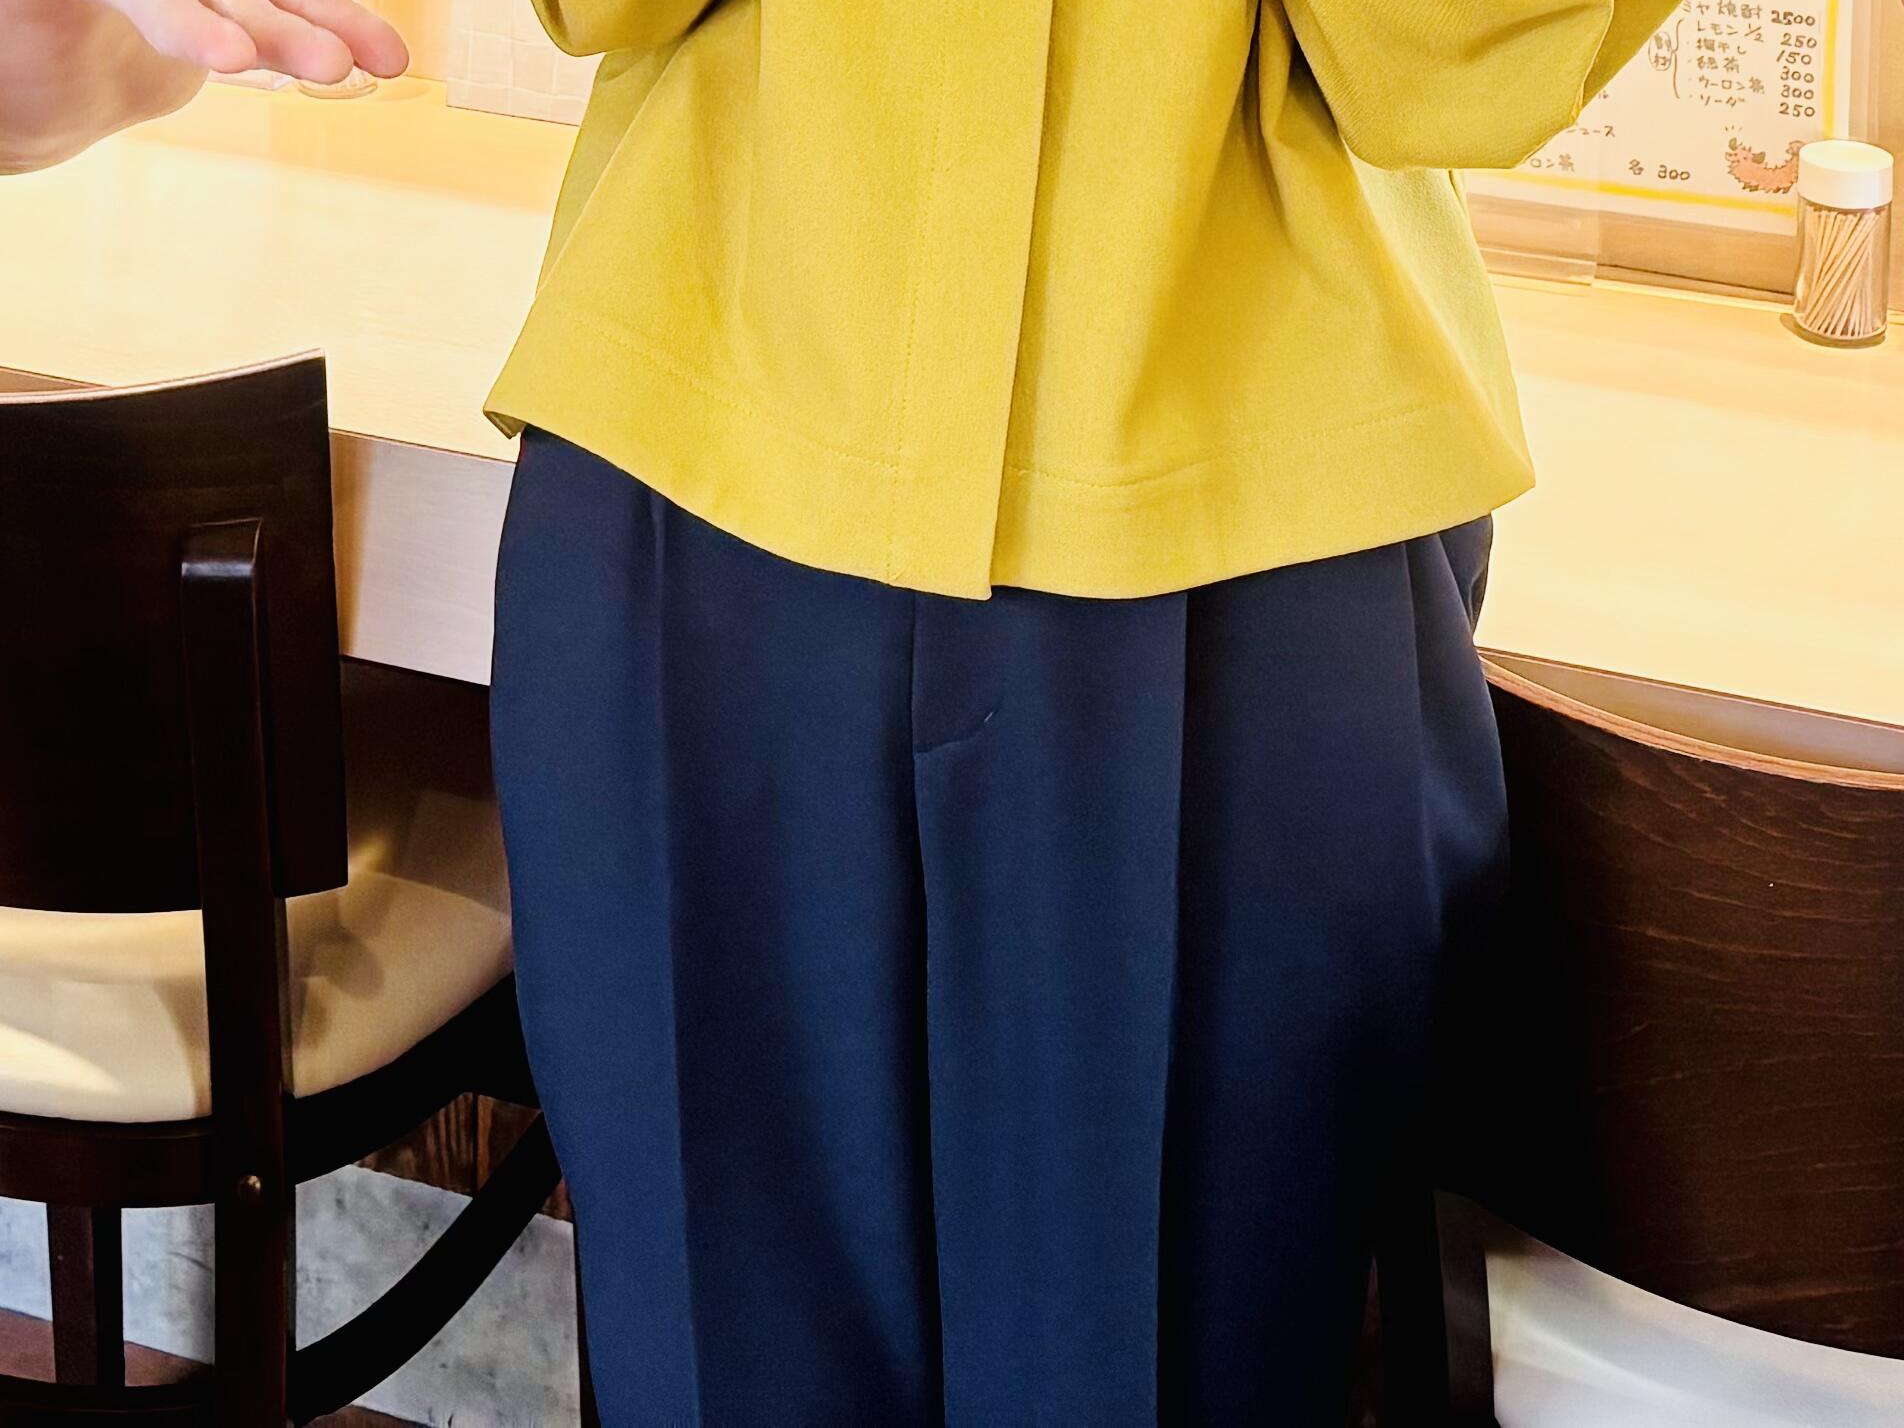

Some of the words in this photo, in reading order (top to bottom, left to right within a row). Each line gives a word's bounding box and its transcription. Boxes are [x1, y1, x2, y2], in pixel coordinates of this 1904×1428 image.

[1771, 10, 1816, 27] 2500
[1697, 21, 1739, 37] レモン
[1781, 33, 1818, 49] 250
[1776, 51, 1812, 67] 150
[1781, 67, 1814, 84] 300
[1697, 76, 1765, 95] ウーロン茶
[1780, 85, 1814, 100] 300
[1700, 95, 1746, 108] ソーダ
[1778, 103, 1816, 118] 250
[1658, 164, 1690, 182] 300
